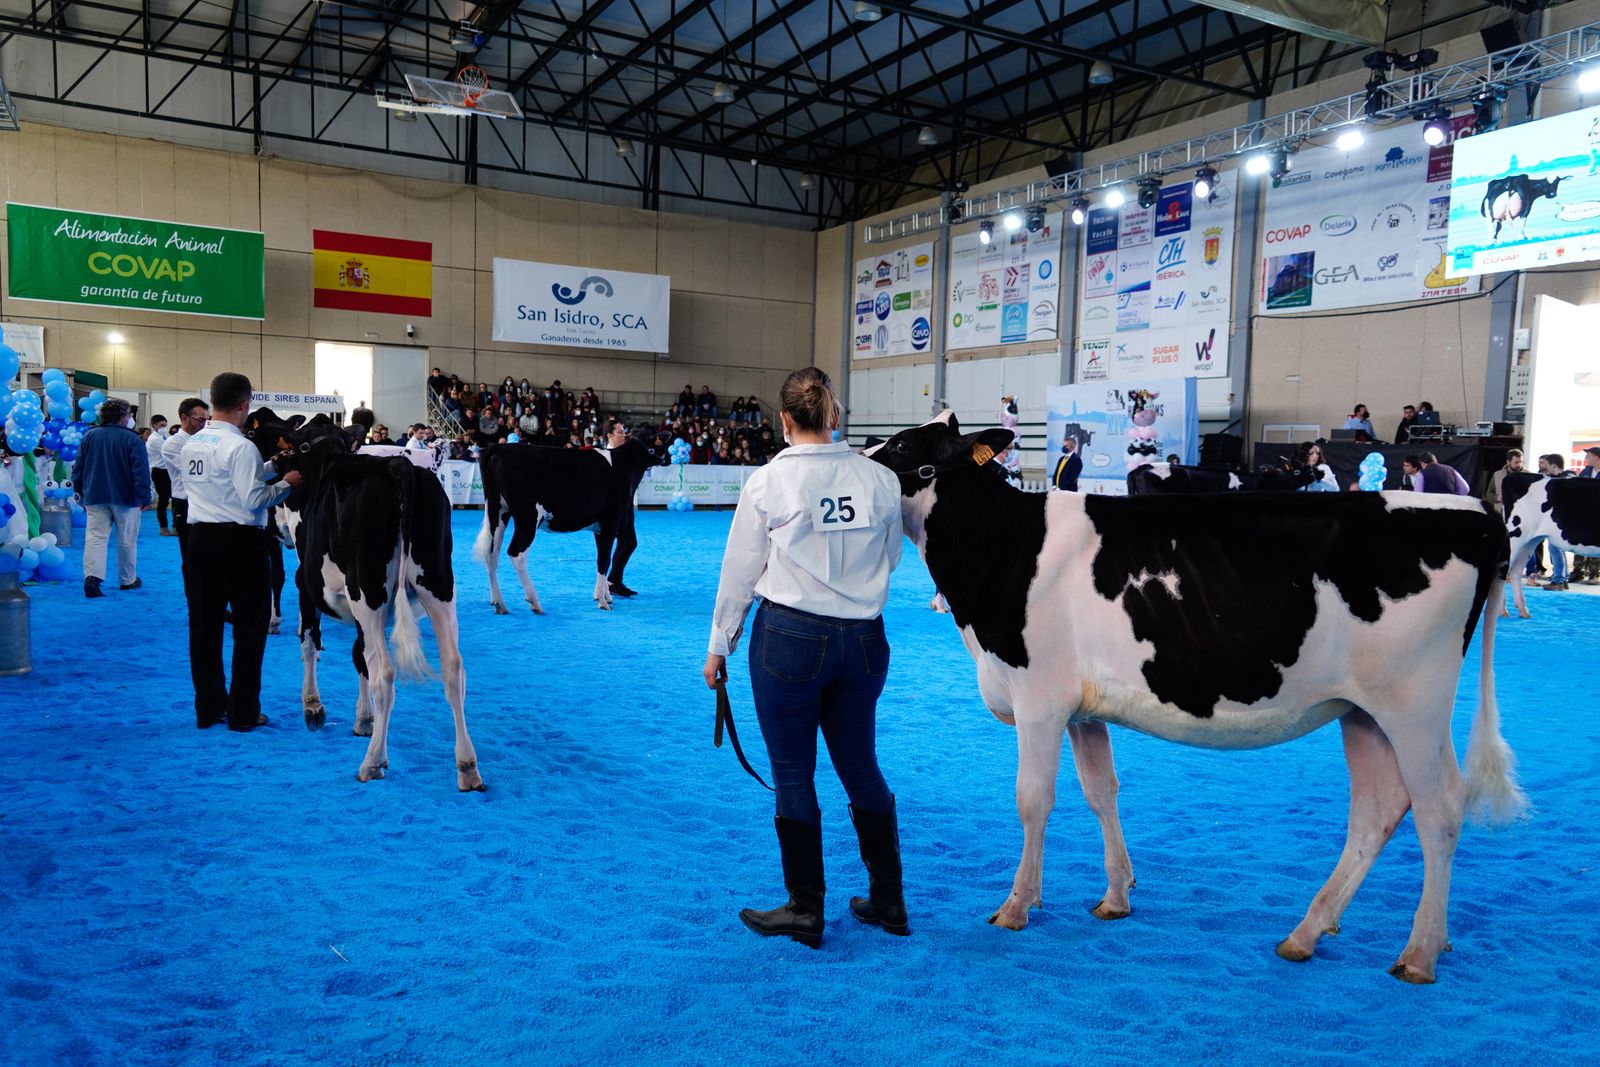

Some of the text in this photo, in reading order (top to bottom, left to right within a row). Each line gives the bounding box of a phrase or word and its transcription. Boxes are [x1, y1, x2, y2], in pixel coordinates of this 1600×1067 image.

[54, 218, 225, 256] Alimentación Animal
[1266, 224, 1312, 245] COVAP
[87, 251, 196, 283] COVAP
[1482, 254, 1520, 265] COVAP
[1314, 264, 1360, 286] GEA
[80, 285, 203, 306] garantía de futuro
[517, 305, 649, 330] San Isidro, SCA
[541, 333, 627, 347] Ganaderos desde 1965
[1152, 345, 1180, 355] SUGAR
[1152, 355, 1172, 364] PLUS
[274, 394, 300, 403] SIRES
[189, 459, 204, 476] 20
[820, 495, 856, 524] 25
